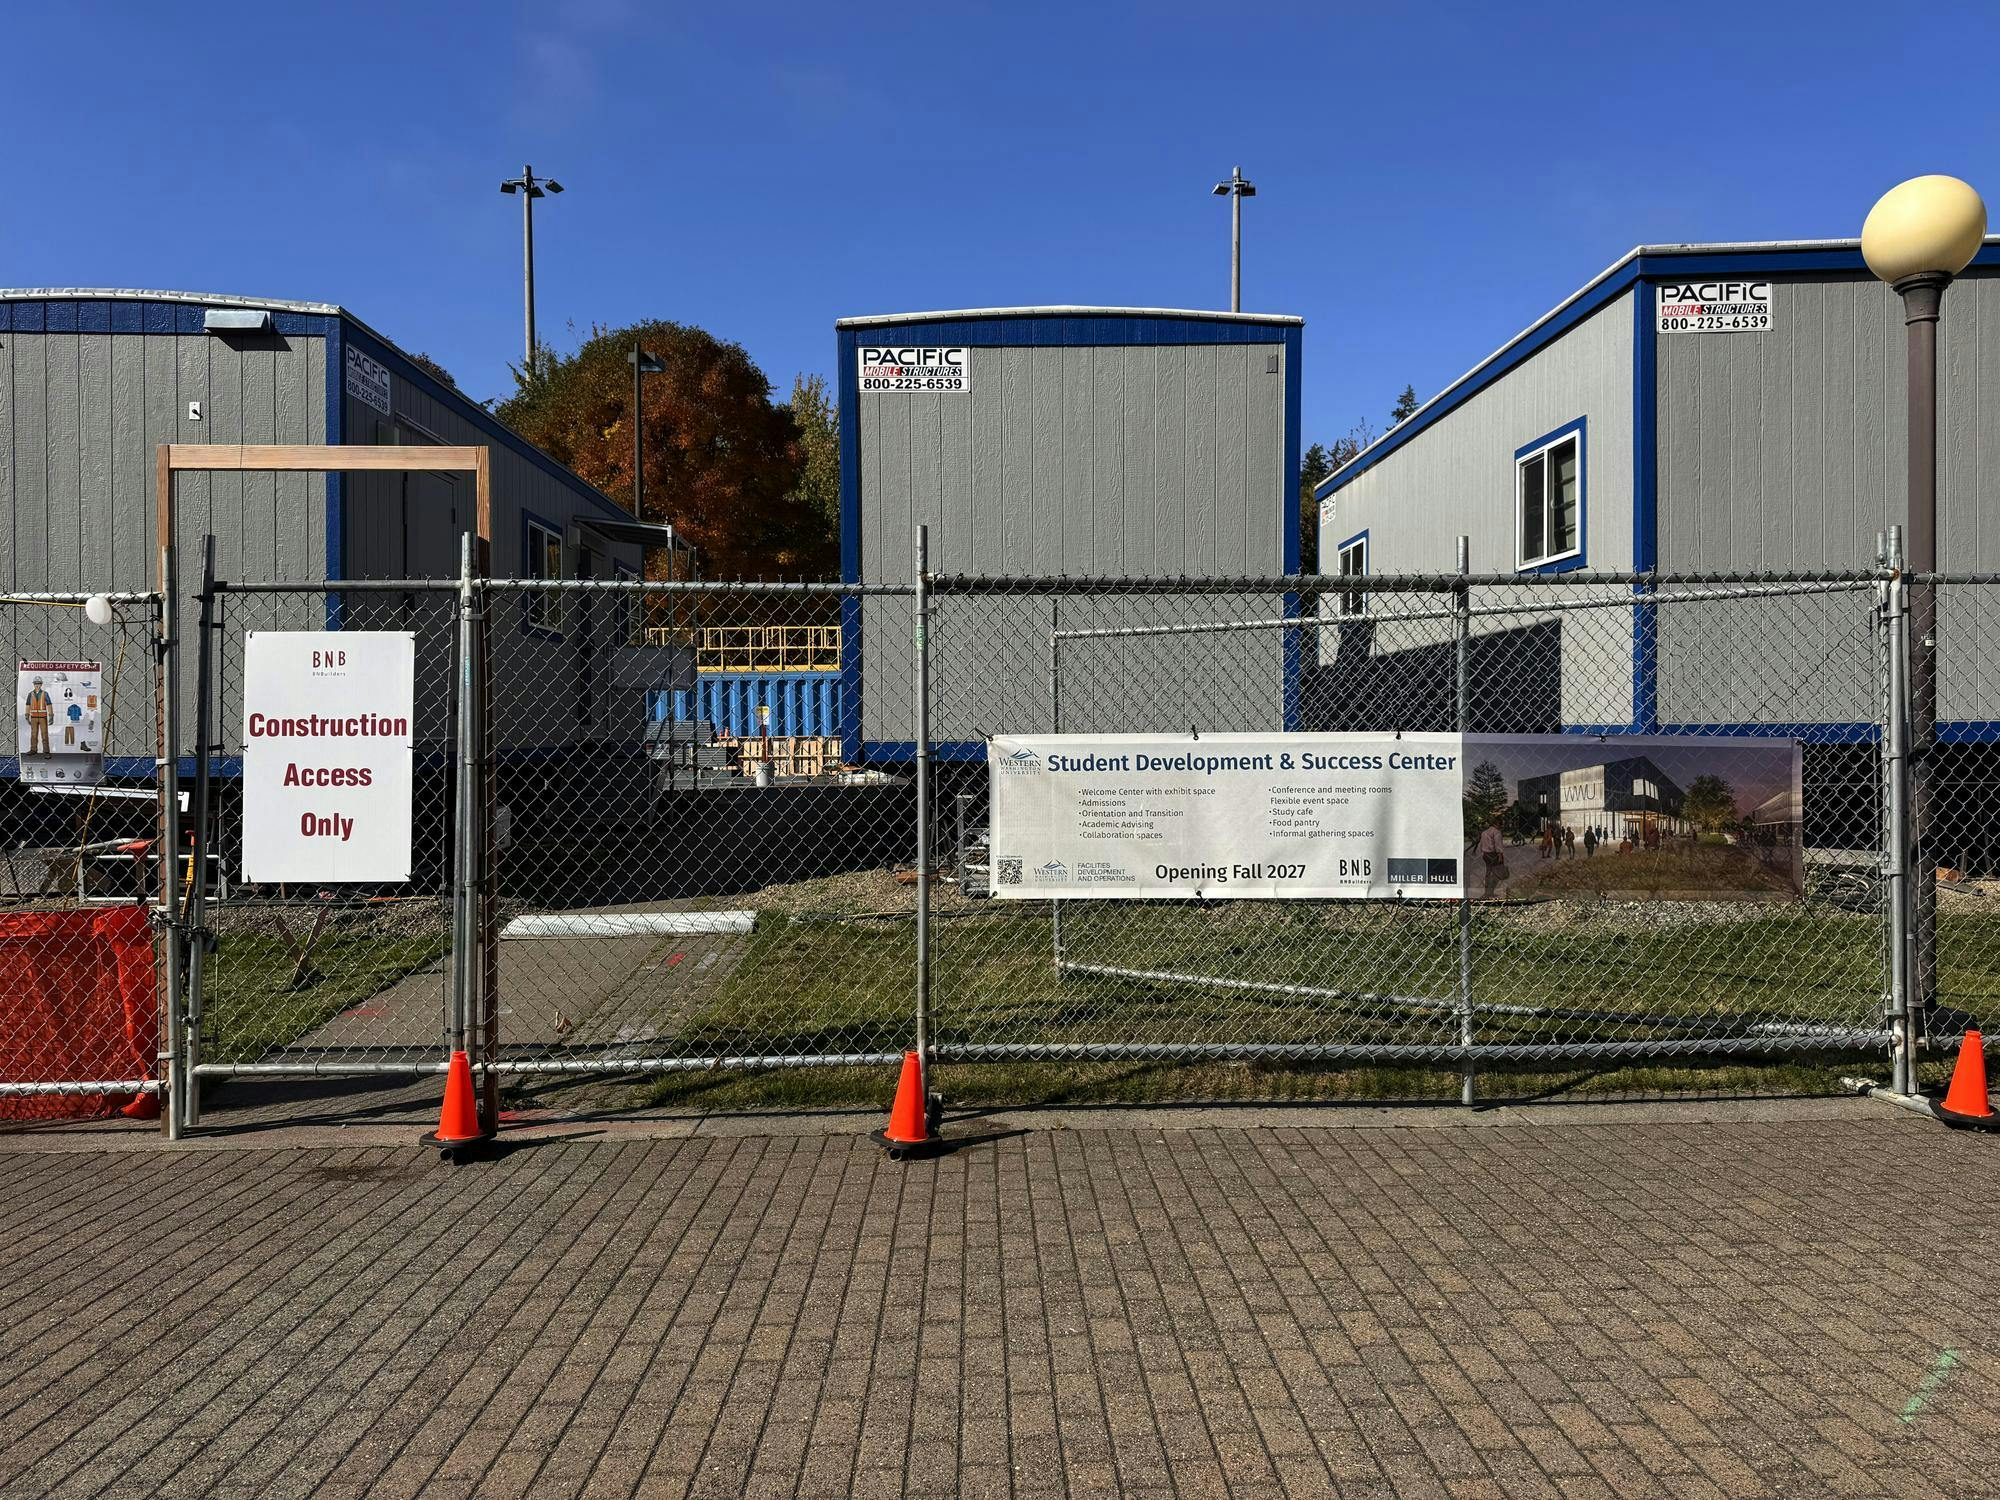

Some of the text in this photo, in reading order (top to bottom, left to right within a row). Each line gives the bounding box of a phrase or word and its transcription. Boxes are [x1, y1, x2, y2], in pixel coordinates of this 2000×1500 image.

[1662, 303, 1767, 316] MOBILE STRUCTURES
[1661, 316, 1768, 330] 800-225-6539
[864, 366, 962, 376] MOBILE STRUCTURES
[863, 378, 962, 389] 800-225-6539
[312, 650, 346, 668] BNB
[249, 713, 407, 737] Construction
[1047, 752, 1457, 775] Student Development & Success Center
[283, 763, 372, 787] Access
[1081, 787, 1216, 796] Welcome Center with exhibit space
[1271, 785, 1393, 795] Conference and meeting rooms
[1563, 782, 1596, 802] WWU
[1081, 799, 1126, 807] Admissions
[1270, 796, 1349, 806] Flexible event space
[1082, 809, 1184, 818] Orientation and Transition
[1272, 807, 1314, 816] Study cafe
[301, 812, 354, 841] Only
[1081, 820, 1154, 829] Academic Advising
[1272, 818, 1320, 828] Food pantry
[1082, 831, 1163, 840] Collaboration spaces
[1272, 829, 1375, 839] Informal gathering spaces
[1155, 863, 1306, 882] Opening Fall 2027
[1339, 859, 1372, 876] BNB
[1390, 874, 1455, 882] MILLER HULL
